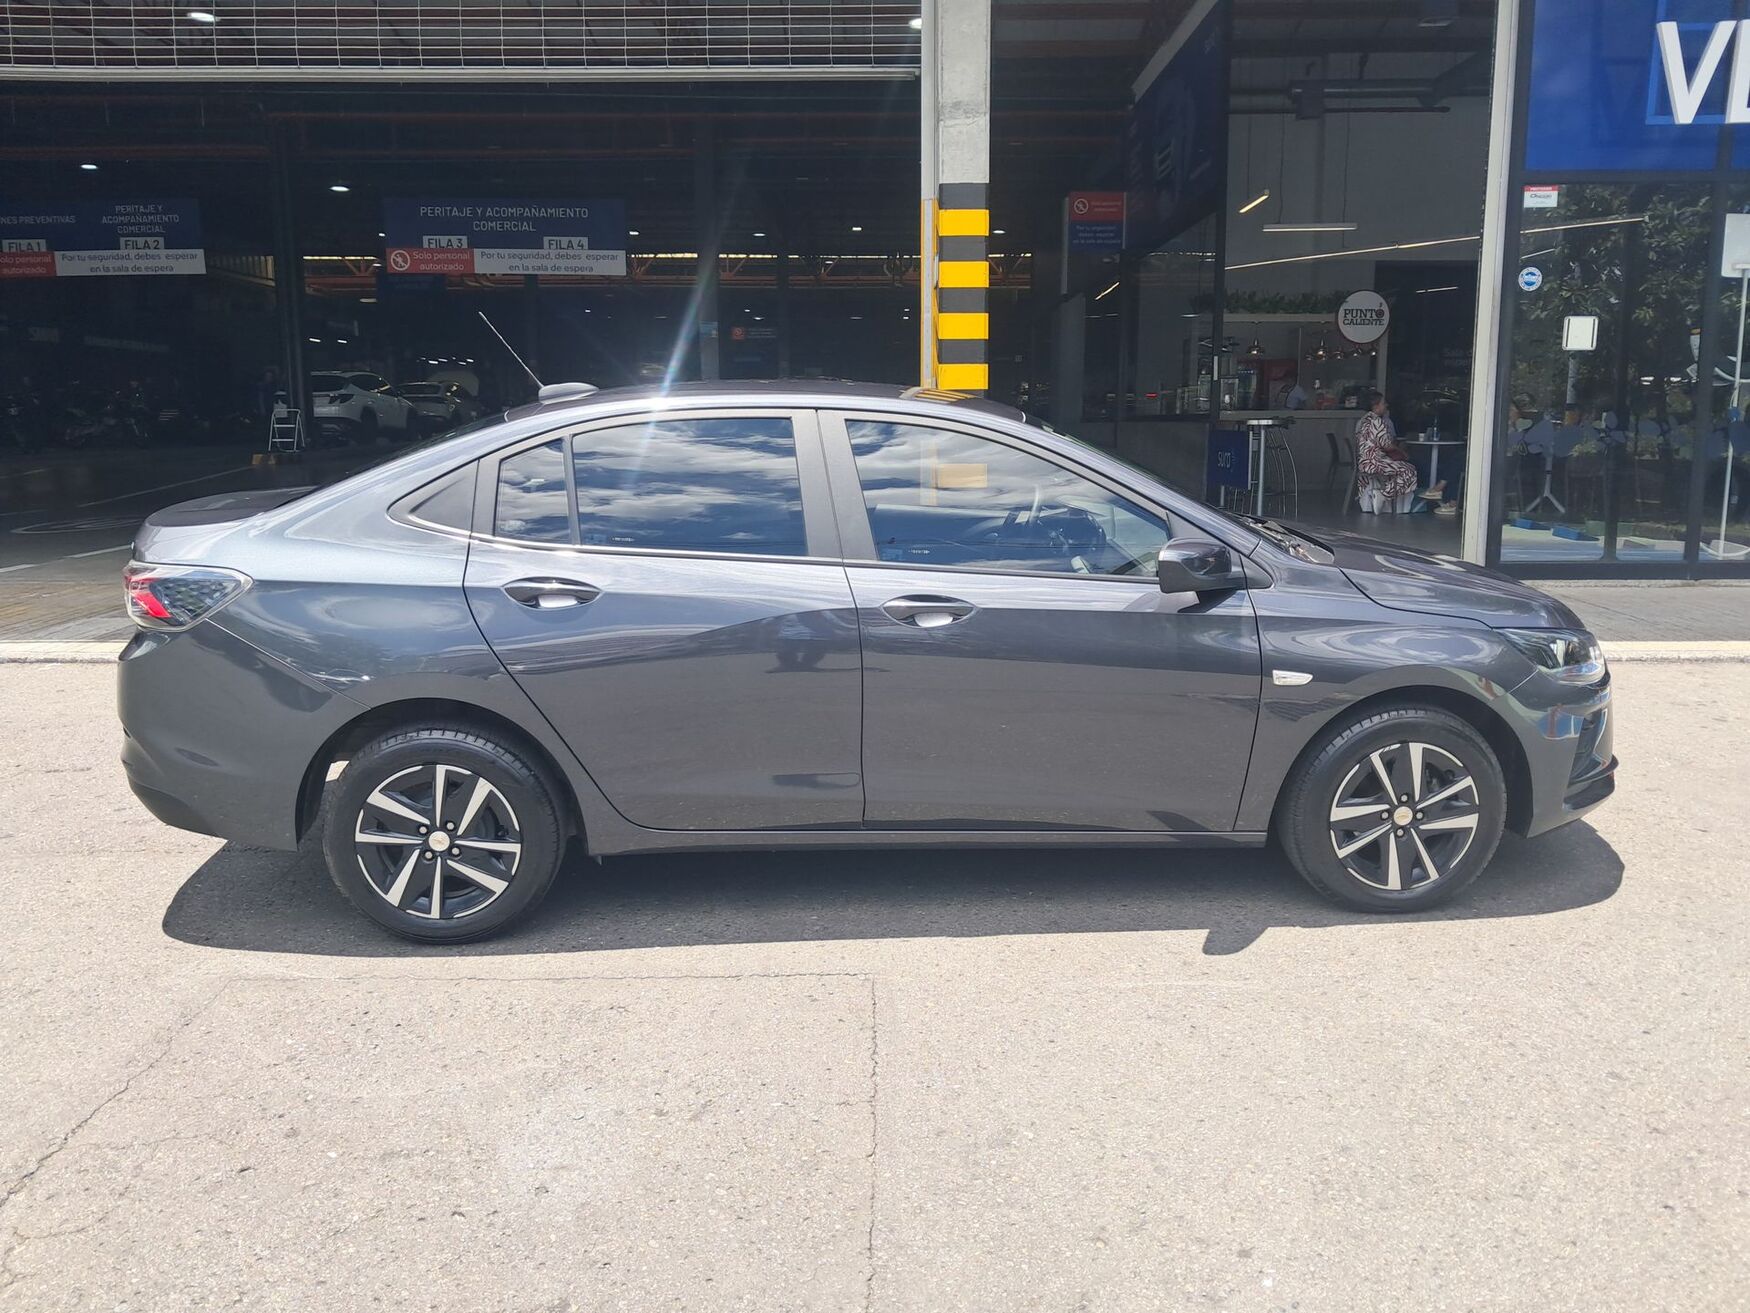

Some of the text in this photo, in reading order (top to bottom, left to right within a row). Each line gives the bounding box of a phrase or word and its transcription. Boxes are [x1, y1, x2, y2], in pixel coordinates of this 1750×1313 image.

[115, 203, 155, 214] PERITAJE
[420, 205, 589, 218] PERITAJE Y ACOMPAÑAMIENTO
[19, 215, 76, 225] PREVENTIVAS
[102, 213, 180, 224] ACOMPAÑAMIENTO
[117, 225, 166, 234] COMERCIAL
[473, 220, 537, 232] COMERCIAL
[8, 242, 34, 252] FILA
[124, 239, 160, 250] FILA 2
[427, 238, 463, 248] FILA 3
[548, 239, 584, 250] FILA 4
[15, 255, 52, 264] personal
[62, 253, 75, 262] Por
[77, 253, 86, 261] tu
[134, 252, 161, 261] debes
[165, 253, 198, 262] esperar
[433, 250, 470, 261] personal
[480, 251, 494, 260] Por
[496, 251, 506, 260] tu
[554, 251, 582, 260] debes
[586, 252, 618, 262] esperar
[112, 264, 129, 272] sala
[131, 264, 142, 272] de
[144, 265, 174, 274] espera
[420, 262, 465, 271] autorizado
[521, 263, 530, 271] la
[531, 263, 549, 271] sala
[550, 263, 562, 271] de
[563, 264, 594, 273] espera
[1343, 308, 1385, 319] PUNTO
[1342, 318, 1385, 326] CALIENTE
